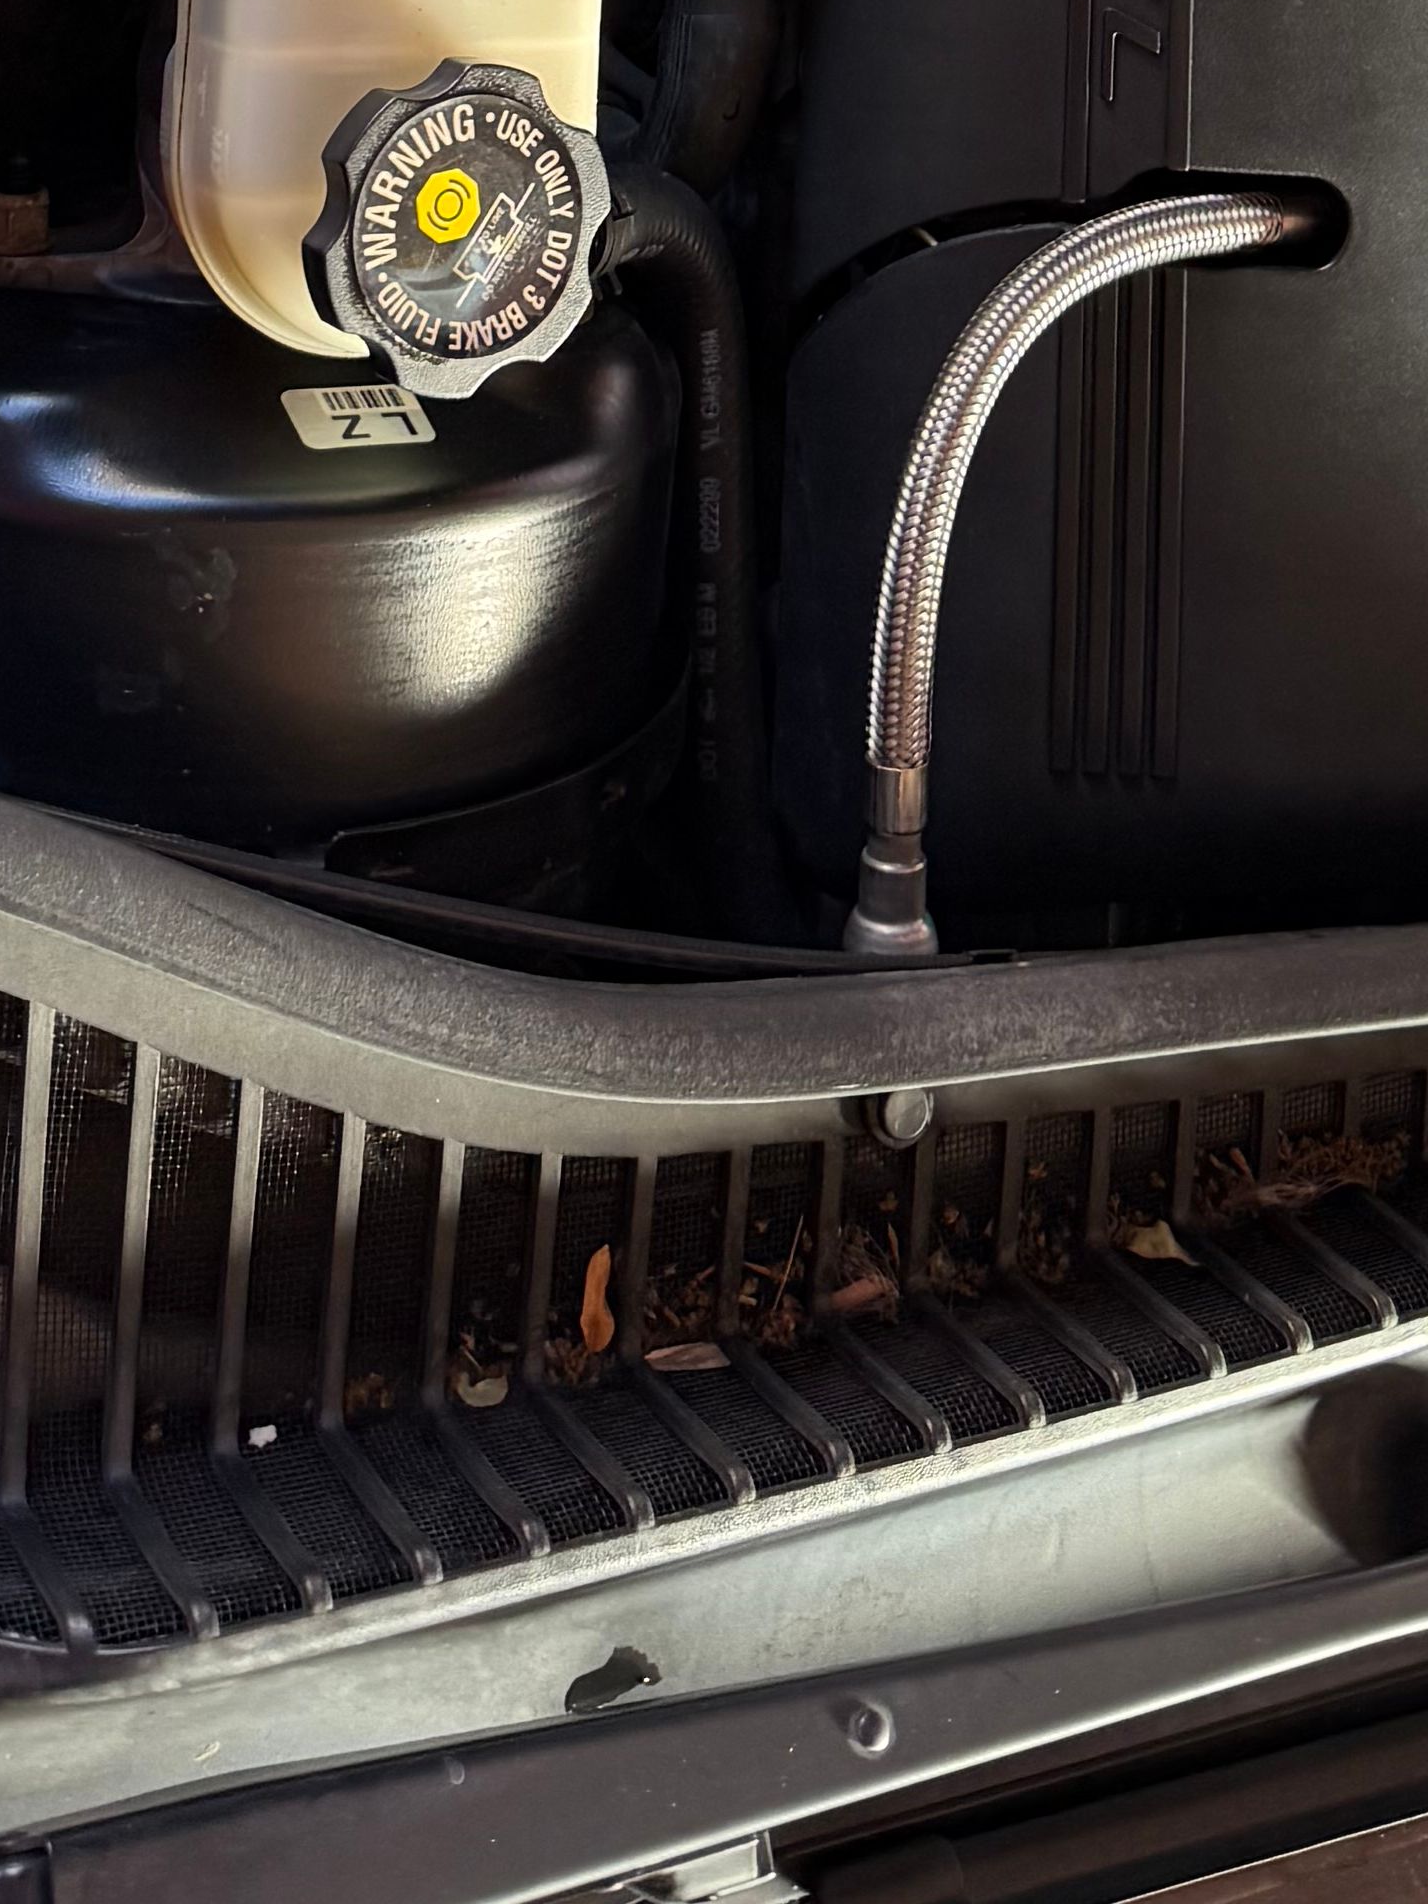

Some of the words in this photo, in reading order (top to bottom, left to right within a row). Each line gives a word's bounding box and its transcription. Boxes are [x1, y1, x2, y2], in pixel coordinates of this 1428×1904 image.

[495, 111, 546, 158] USE
[362, 103, 477, 271] WARNING
[531, 149, 576, 218] ONLY
[535, 229, 573, 289] DOT
[377, 285, 445, 346] FLUID
[521, 284, 547, 306] 3
[447, 301, 528, 351] BRAKE
